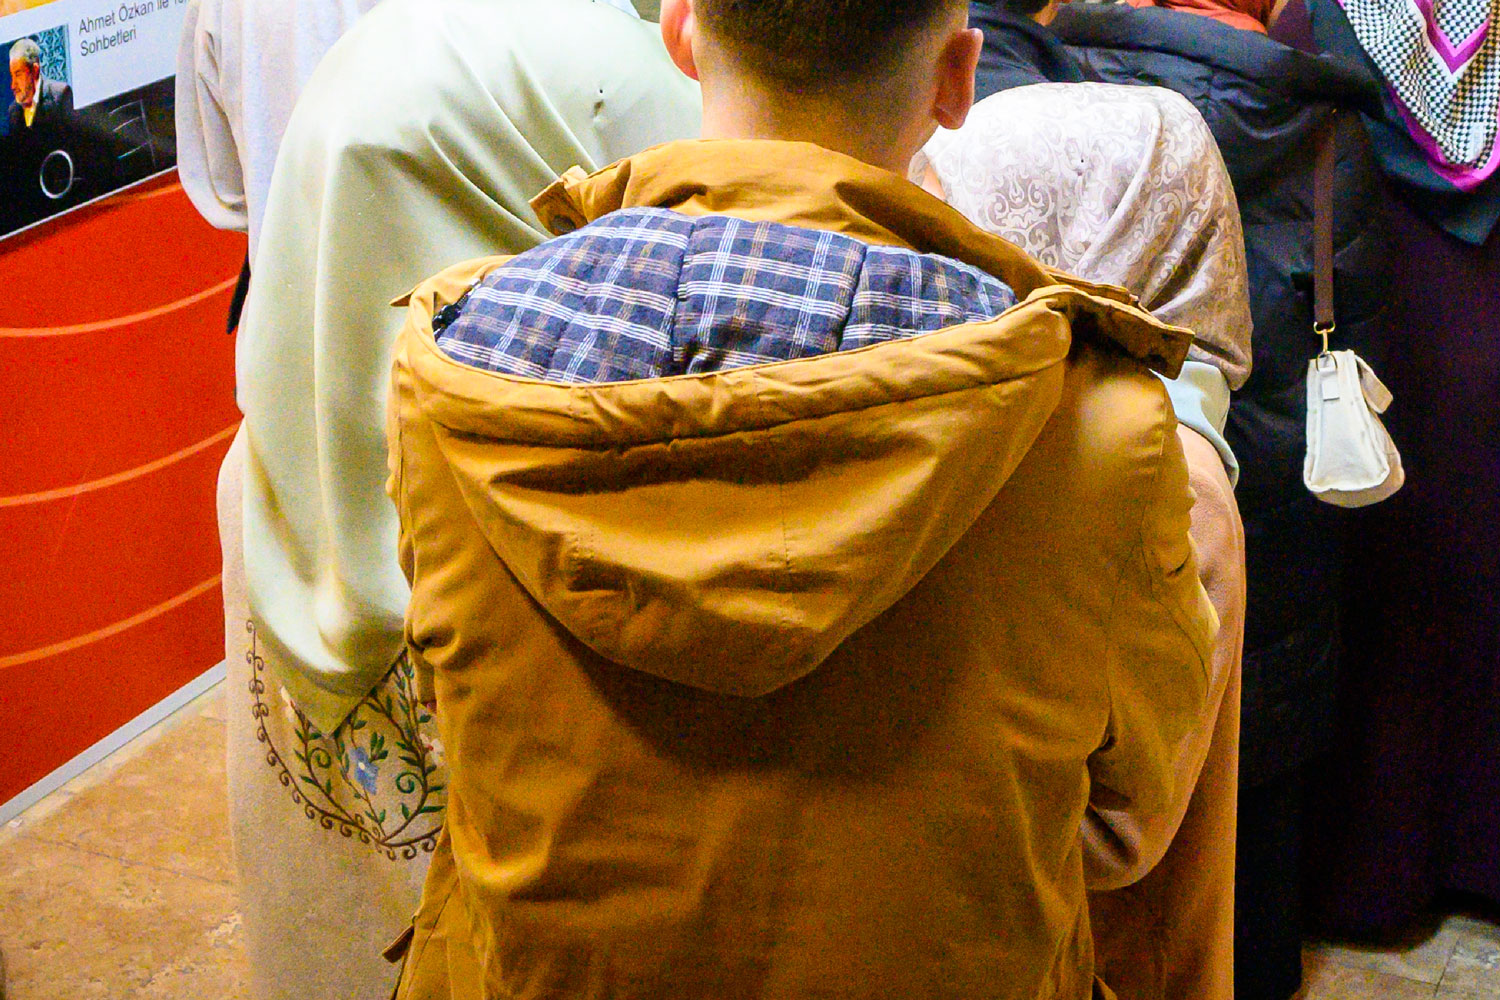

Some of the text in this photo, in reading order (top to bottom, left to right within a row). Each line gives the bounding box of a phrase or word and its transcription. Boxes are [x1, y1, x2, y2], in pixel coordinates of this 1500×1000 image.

[78, 10, 116, 36] Ahmet
[118, 1, 154, 22] Özkan
[80, 25, 138, 57] Sohbetleri
